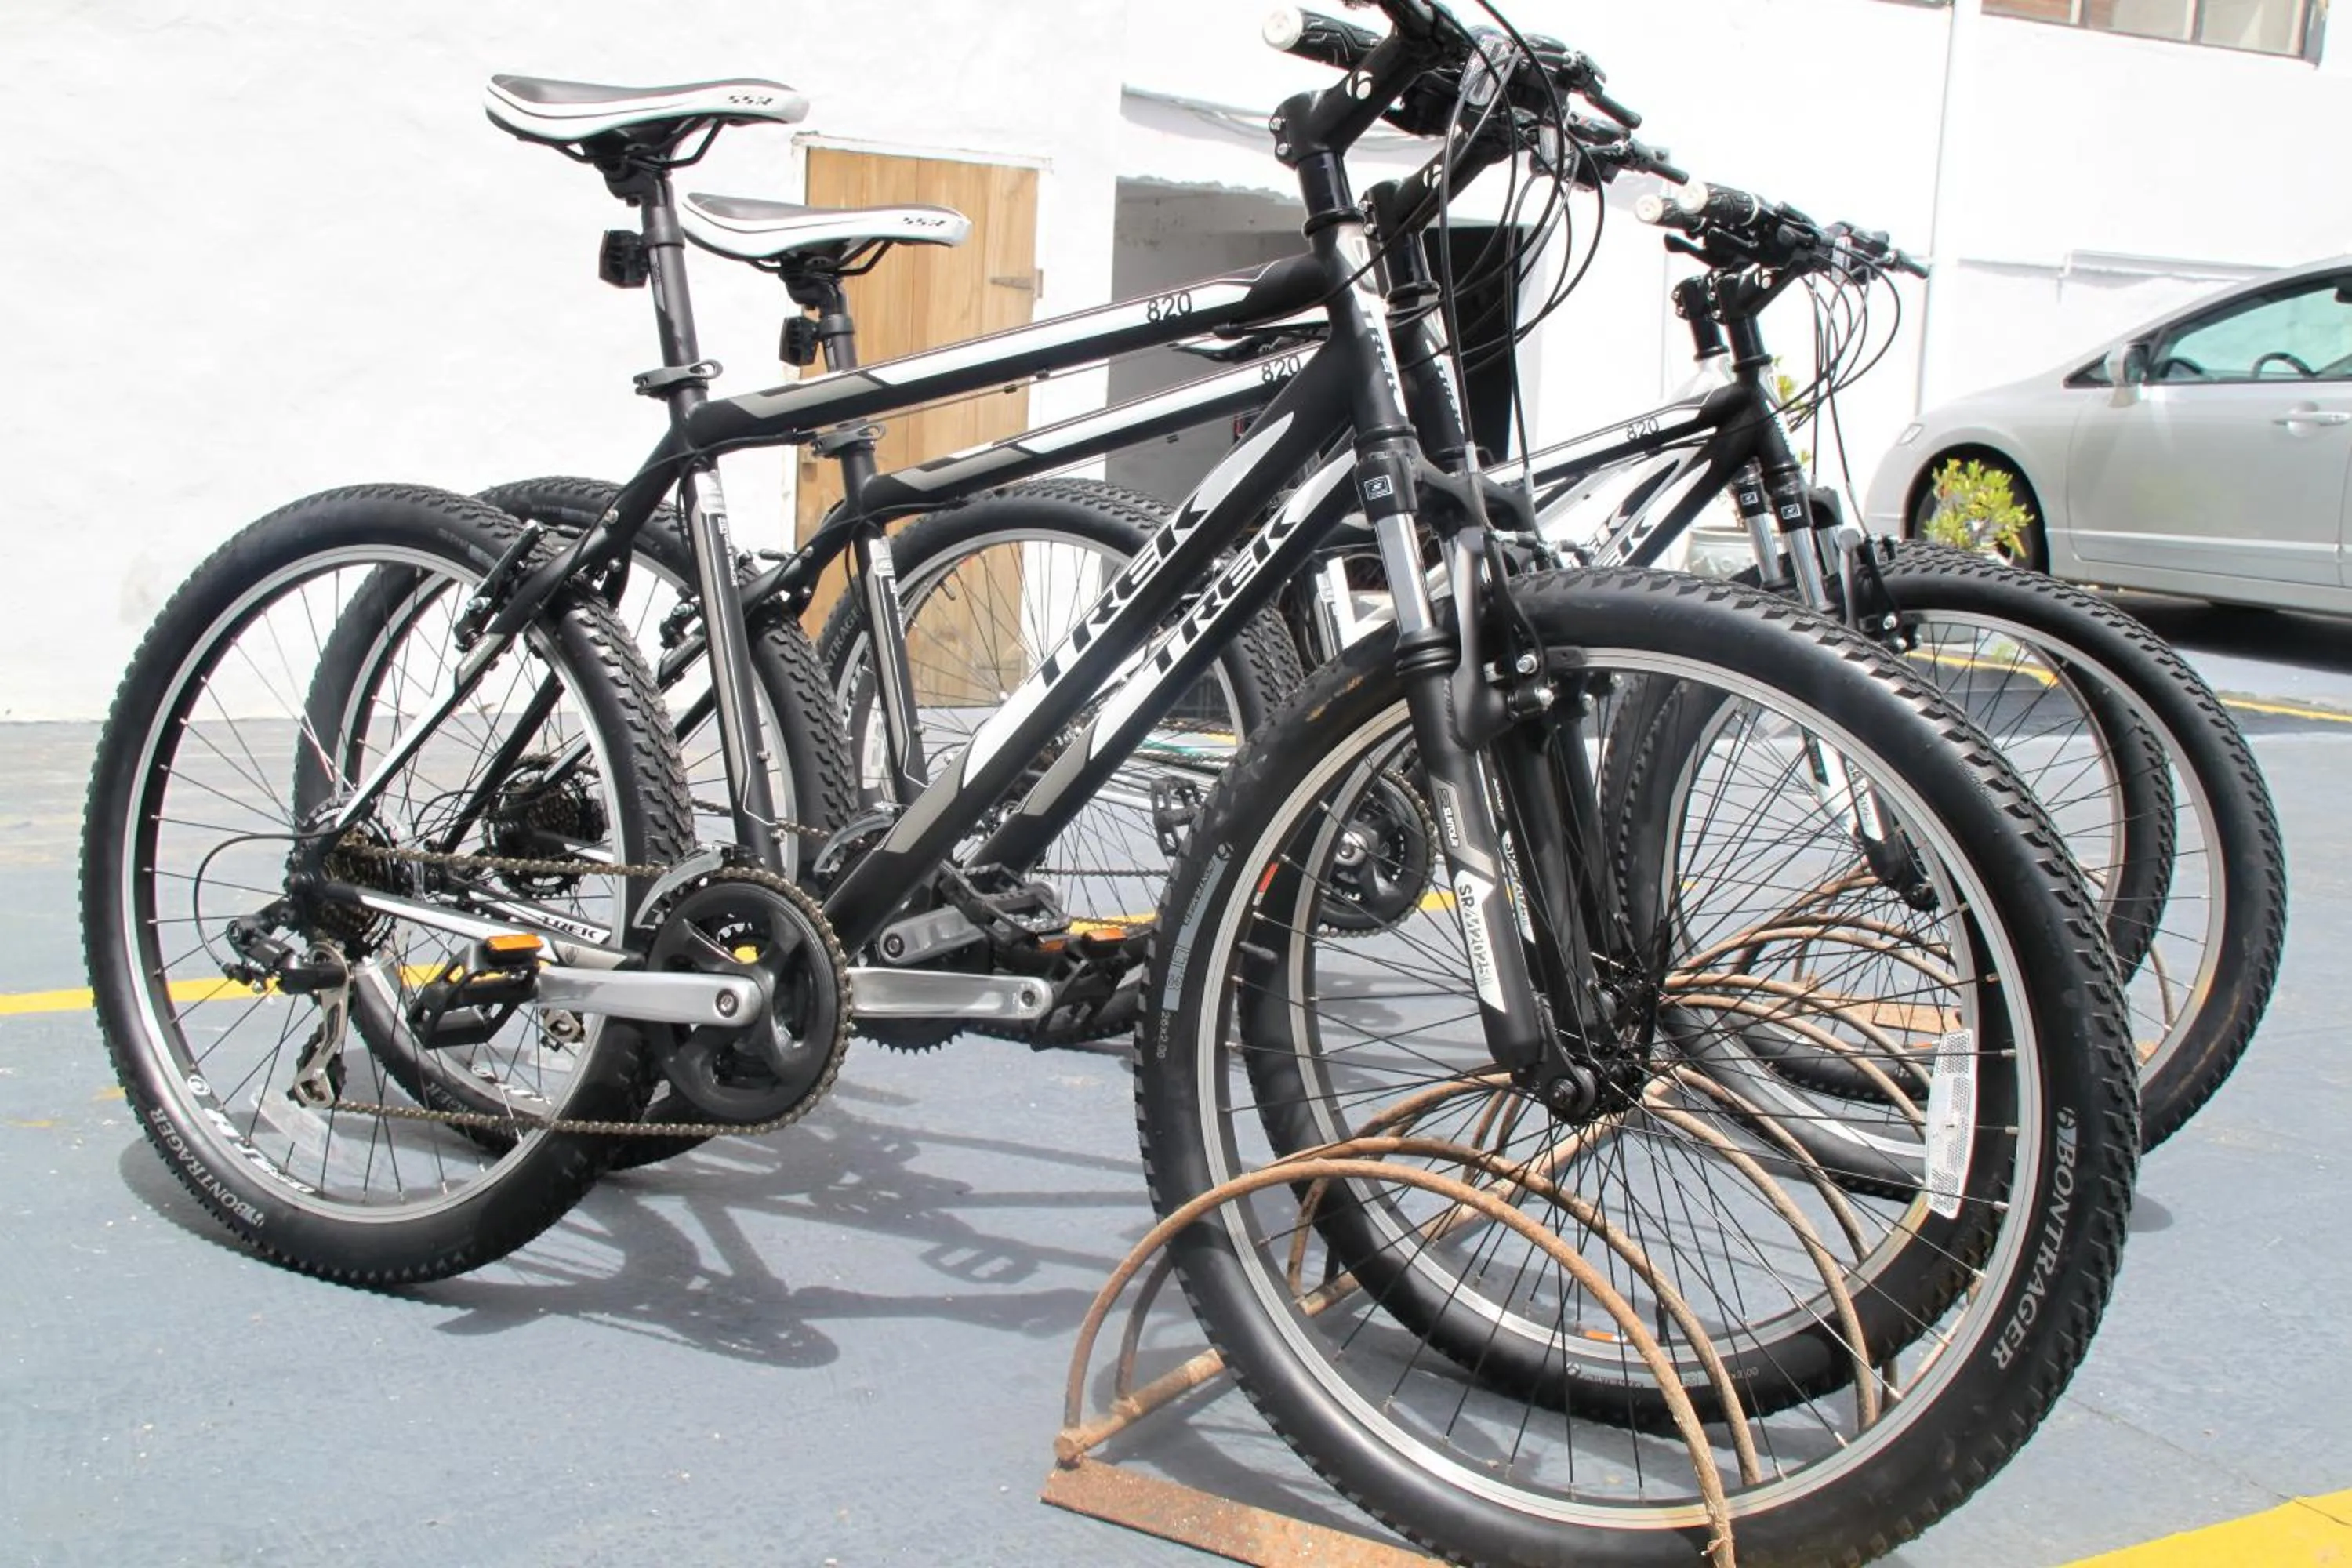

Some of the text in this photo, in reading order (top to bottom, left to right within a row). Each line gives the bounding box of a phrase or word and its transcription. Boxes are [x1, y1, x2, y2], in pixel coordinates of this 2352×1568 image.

[1147, 291, 1192, 323] 820
[1261, 355, 1301, 383] 820
[1626, 417, 1660, 441] 820
[1029, 490, 1209, 688] TREK
[1146, 505, 1297, 675] TREK
[150, 1108, 250, 1216] BONTRAGER
[1991, 1143, 2077, 1370] BONTRAGER
